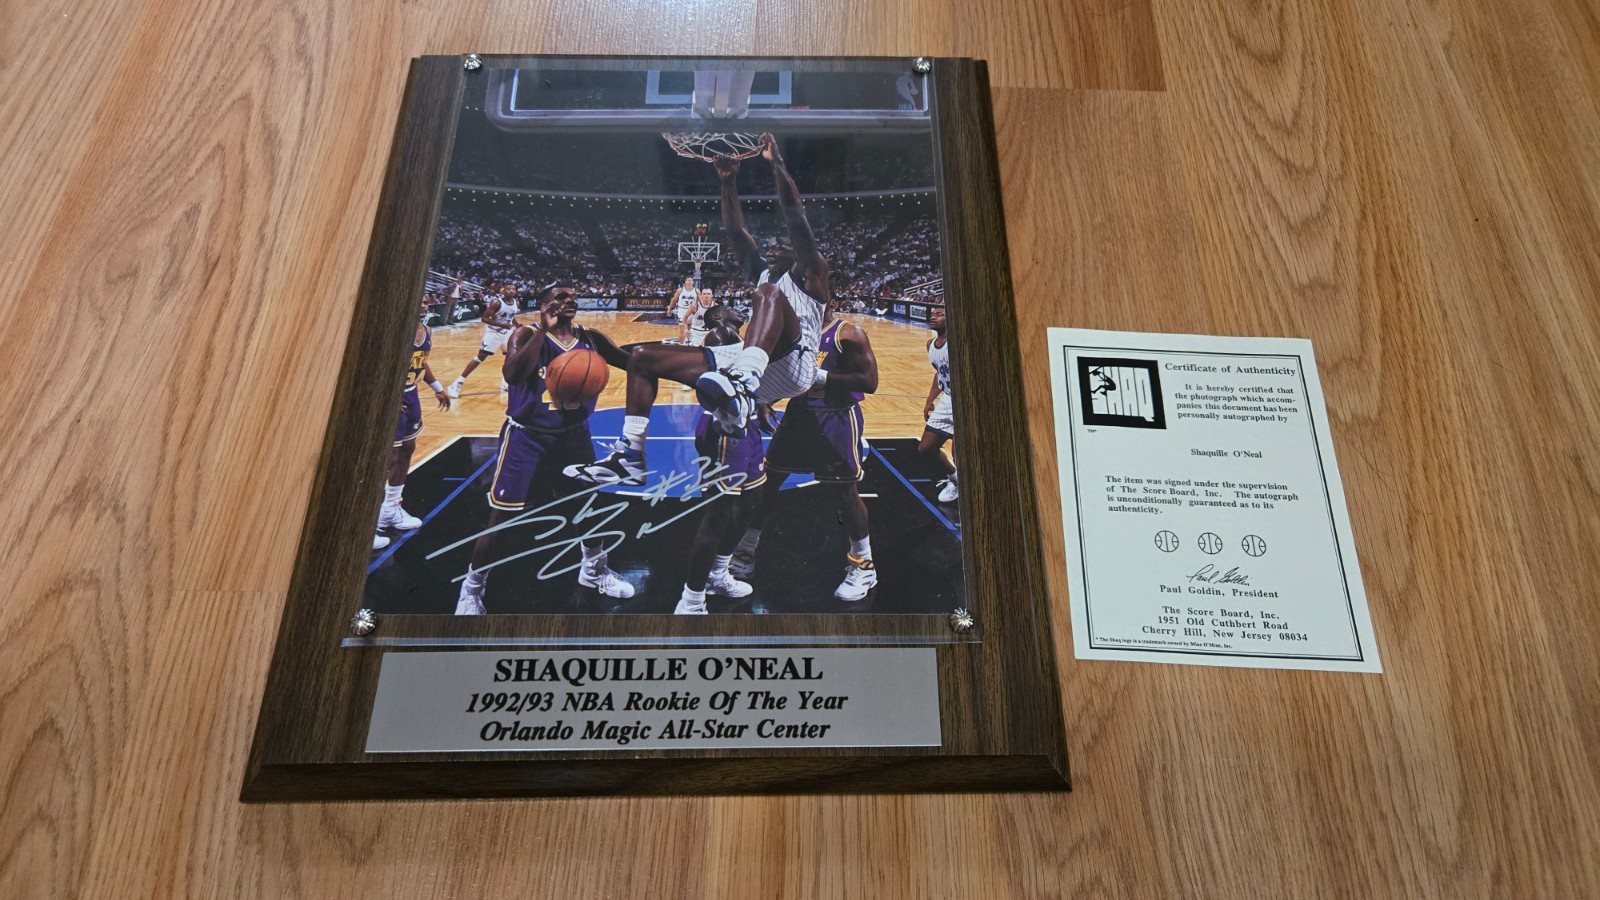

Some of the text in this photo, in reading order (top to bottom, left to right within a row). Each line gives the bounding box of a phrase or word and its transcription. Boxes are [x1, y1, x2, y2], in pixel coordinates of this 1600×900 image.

[1165, 363, 1217, 372] Certificate
[1236, 366, 1295, 376] Authenticity
[1206, 385, 1234, 393] hereby
[1190, 393, 1238, 402] photograph
[1222, 404, 1262, 412] document
[1178, 412, 1287, 423] personally autographed by
[1191, 448, 1228, 458] Shaquille
[1124, 476, 1143, 484] item
[1164, 478, 1191, 487] signed
[1117, 496, 1182, 506] unconditionally
[1169, 488, 1199, 497] Board,
[1254, 493, 1298, 501] autograph
[1108, 505, 1162, 515] authenticity.
[1160, 585, 1278, 598] Paul Goldin, President
[1162, 606, 1279, 619] The Score Board, Inc.
[1158, 616, 1288, 630] 1951 Old Cuthbert Road
[1142, 626, 1308, 642] Cherry Hill, New Jersey 08034
[494, 657, 823, 686] SHAQUILLE O'NEAL
[466, 691, 848, 715] 1992/93 NBA Rookie Of The Year
[480, 719, 830, 745] Orlando Magic All-Star Center
